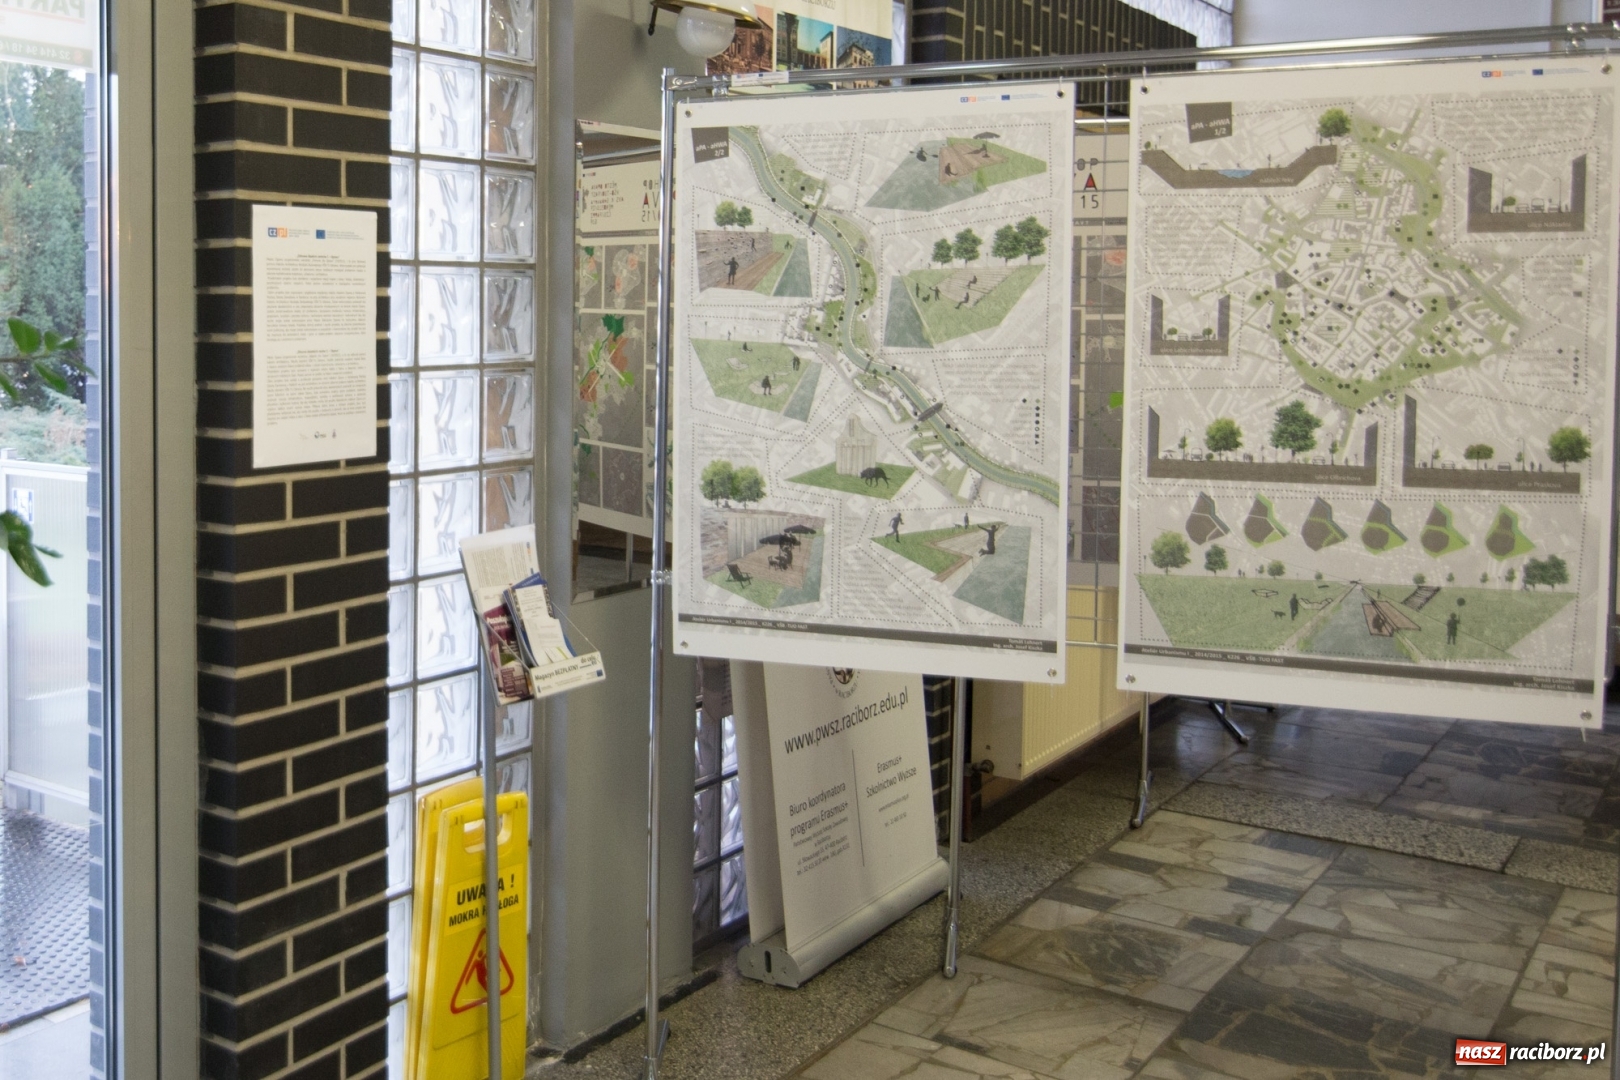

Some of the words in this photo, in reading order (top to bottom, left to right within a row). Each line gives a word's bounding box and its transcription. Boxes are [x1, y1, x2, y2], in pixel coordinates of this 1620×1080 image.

[534, 671, 555, 682] Magazyn
[784, 686, 909, 755] www.pwsz.raciborz.edu.pl
[877, 755, 902, 774] Erasmus+
[789, 801, 807, 817] Biuro
[808, 782, 846, 808] koordynatora
[866, 776, 897, 798] Szkolnictwo
[790, 814, 820, 839] programu
[820, 800, 848, 821] Erasmus+
[456, 877, 505, 906] UWAA
[449, 907, 480, 927] MOKRA
[482, 893, 519, 916] PŁOGA
